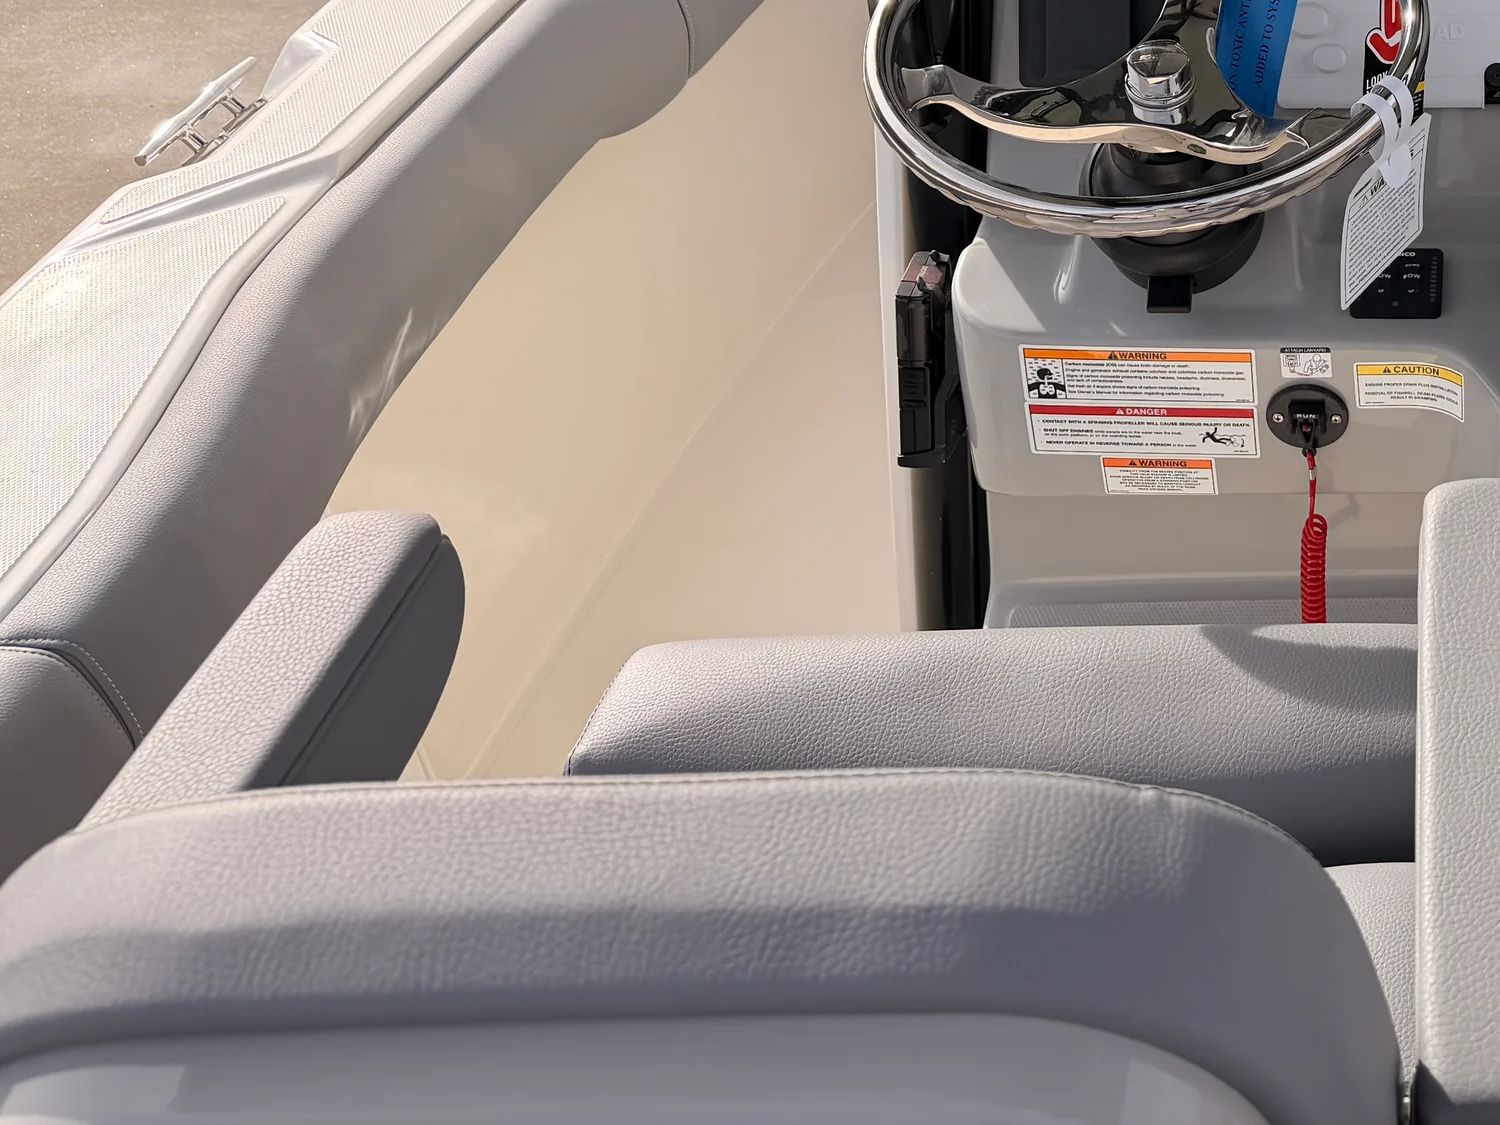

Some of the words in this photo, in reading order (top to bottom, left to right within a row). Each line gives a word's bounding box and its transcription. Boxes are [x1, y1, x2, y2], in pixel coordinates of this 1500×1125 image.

[1227, 29, 1245, 91] ON-TOXIC
[1254, 44, 1269, 88] ADDED
[1262, 24, 1274, 42] TO
[1119, 352, 1167, 360] WARNING
[1393, 366, 1440, 375] CAUTION
